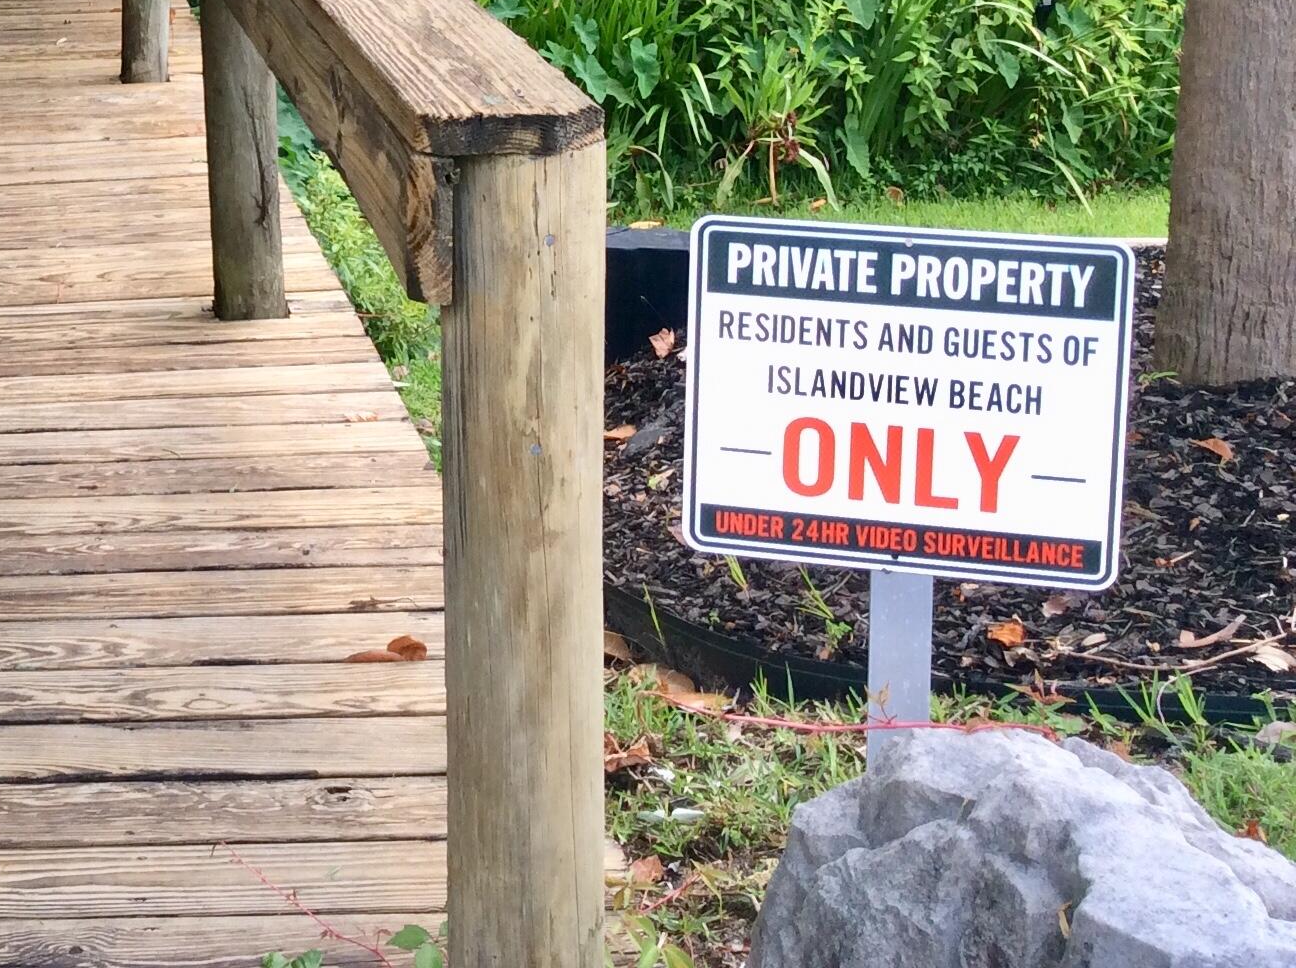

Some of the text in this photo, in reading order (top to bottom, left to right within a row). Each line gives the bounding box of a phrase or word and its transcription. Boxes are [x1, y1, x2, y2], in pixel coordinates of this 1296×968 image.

[727, 242, 1095, 308] PRIVATE PROPERTY
[719, 310, 1099, 366] RESIDENTS AND GUESTS OF
[768, 365, 1042, 415] ISLANDVIEW BEACH
[782, 416, 1021, 514] ONLY
[715, 511, 1084, 568] UNDER 24HR VIDEO SURVEILLANCE
